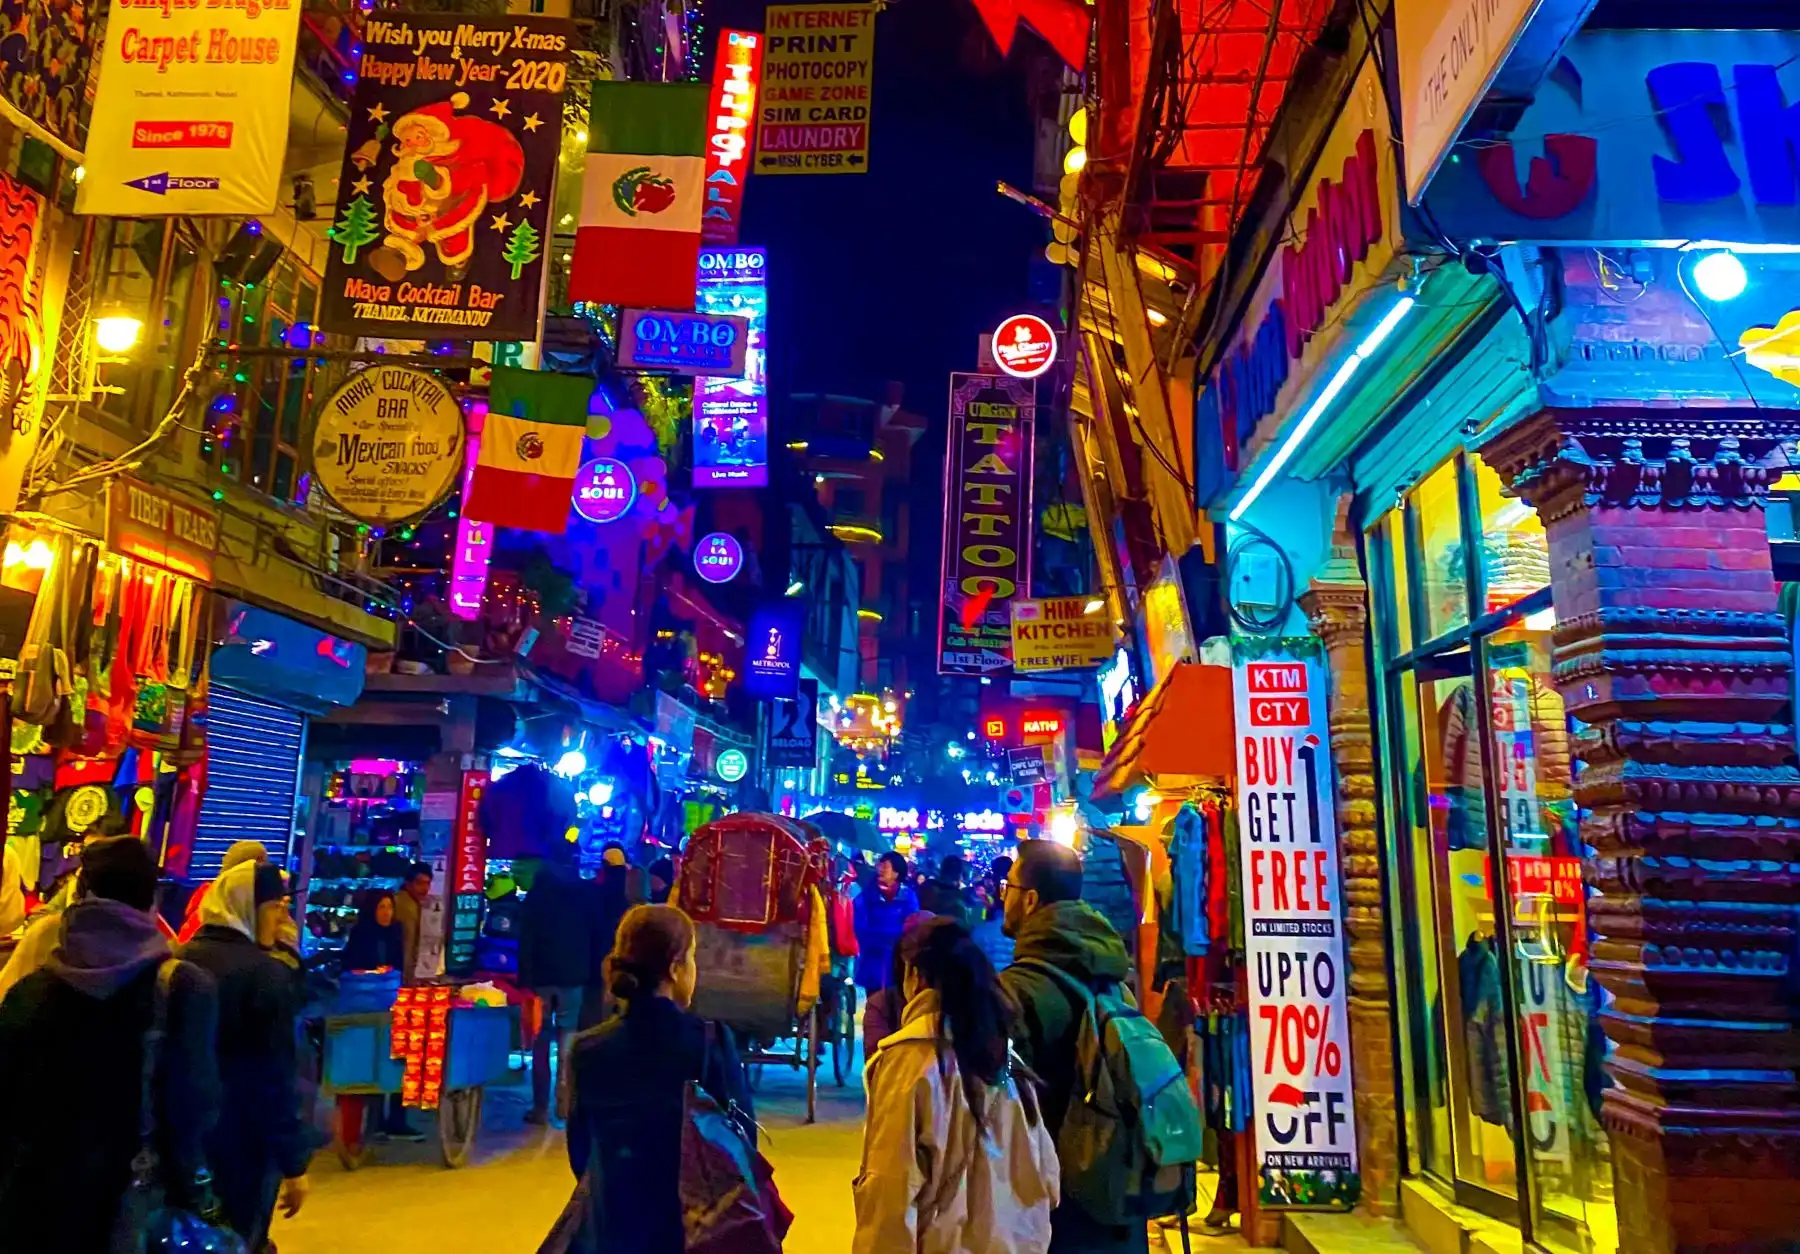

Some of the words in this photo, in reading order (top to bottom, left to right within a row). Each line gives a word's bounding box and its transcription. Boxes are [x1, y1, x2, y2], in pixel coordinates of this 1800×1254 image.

[769, 10, 873, 29] INTERNET
[366, 20, 413, 45] Wish
[413, 29, 452, 56] you
[454, 24, 511, 57] Merry
[511, 26, 567, 51] X-mas
[769, 35, 858, 53] PRINT
[1451, 0, 1480, 81] ONLY
[121, 28, 201, 72] Carpet
[205, 28, 280, 64] House
[450, 46, 463, 59] &
[361, 54, 415, 88] Happy
[416, 56, 455, 81] New
[766, 61, 868, 80] PHOTOCOPY
[764, 86, 818, 101] GAME
[821, 85, 868, 100] ZONE
[763, 107, 800, 122] SIM
[808, 106, 867, 121] CARD
[136, 128, 183, 142] Since
[763, 126, 861, 149] LAUNDRY
[804, 153, 844, 168] CYBER
[141, 178, 162, 189] 1st
[166, 178, 214, 188] Floor
[699, 253, 765, 269] OMBO
[344, 278, 391, 302] Maya
[397, 281, 461, 306] Cocktail
[468, 285, 505, 309] Bar
[353, 303, 409, 322] THAMEL,
[411, 307, 492, 327] KATHMANDU
[636, 317, 735, 347] OMBO
[336, 378, 375, 416] MAYA
[382, 370, 445, 415] COCKTAIL
[377, 398, 409, 419] BAR
[336, 433, 406, 475] Mexican
[594, 464, 614, 473] DE
[593, 475, 615, 485] LA
[580, 487, 625, 499] SOUL
[129, 485, 170, 530] TIBET
[961, 423, 1016, 599] TATTOO
[711, 537, 726, 546] DE
[711, 546, 727, 555] LA
[701, 556, 733, 566] SOUL
[1017, 622, 1111, 640] KITCHEN
[752, 660, 791, 669] METROPOL
[952, 653, 968, 664] 1st
[973, 654, 1005, 665] Floor
[1020, 657, 1048, 665] FREE
[1253, 668, 1300, 689] KTM
[1256, 702, 1301, 721] CTY
[1244, 736, 1294, 786] BUY
[1298, 745, 1321, 843] 1
[1247, 792, 1296, 843] GET
[1250, 850, 1331, 911] FREE
[1254, 922, 1267, 932] ON
[1269, 922, 1299, 933] LIMITED
[1302, 923, 1332, 934] STOCKS
[1257, 952, 1335, 998] UPTO
[1259, 1004, 1341, 1077] 70%
[1267, 1155, 1282, 1166] ON
[1284, 1155, 1304, 1167] NEW
[1307, 1155, 1349, 1168] ARRIVALS
